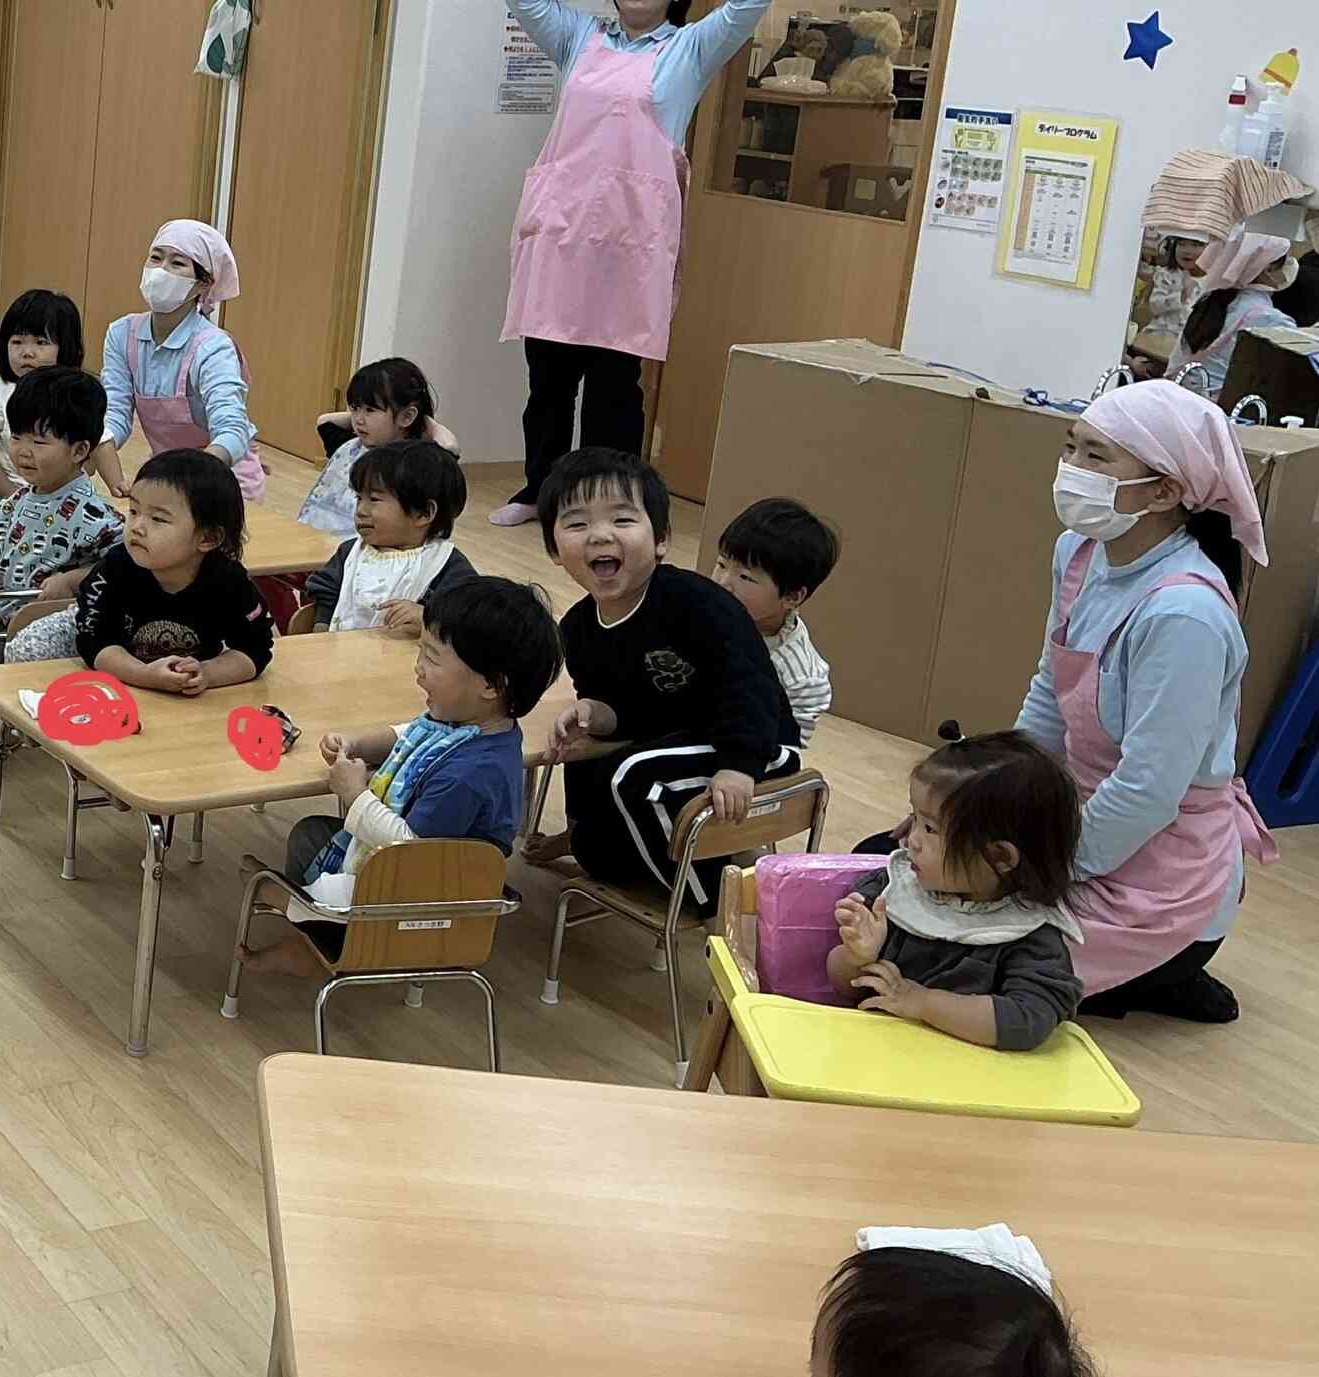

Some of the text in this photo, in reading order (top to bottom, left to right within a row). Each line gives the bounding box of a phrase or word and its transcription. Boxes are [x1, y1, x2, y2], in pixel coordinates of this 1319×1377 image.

[1038, 124, 1098, 139] デイリープログラム
